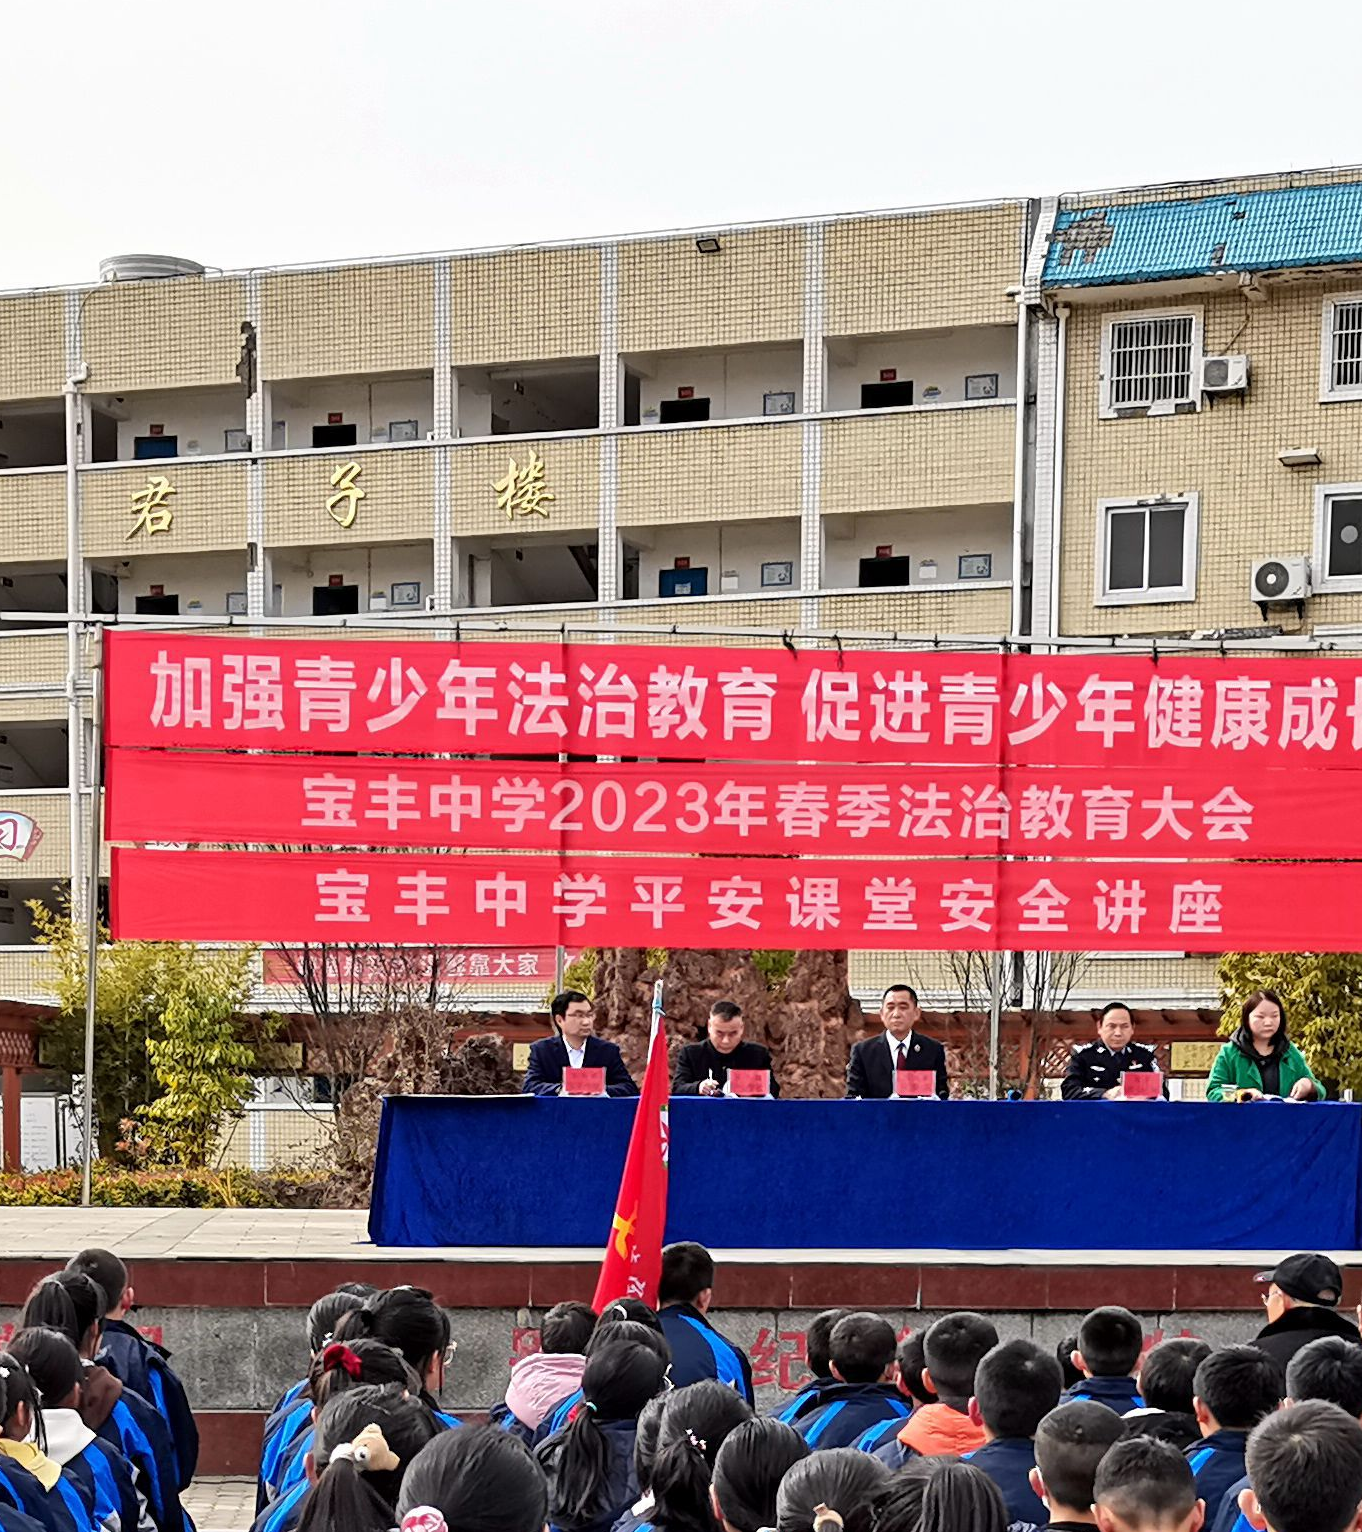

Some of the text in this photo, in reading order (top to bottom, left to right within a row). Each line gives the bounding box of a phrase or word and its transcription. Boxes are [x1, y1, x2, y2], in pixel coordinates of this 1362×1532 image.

[125, 449, 556, 541] 君子楼
[148, 649, 779, 742] 加强青少年法治教育
[300, 772, 1255, 843] 宝丰中学2023年春季法治教育大会
[313, 866, 1224, 935] 宝丰中学平安课堂安全讲座
